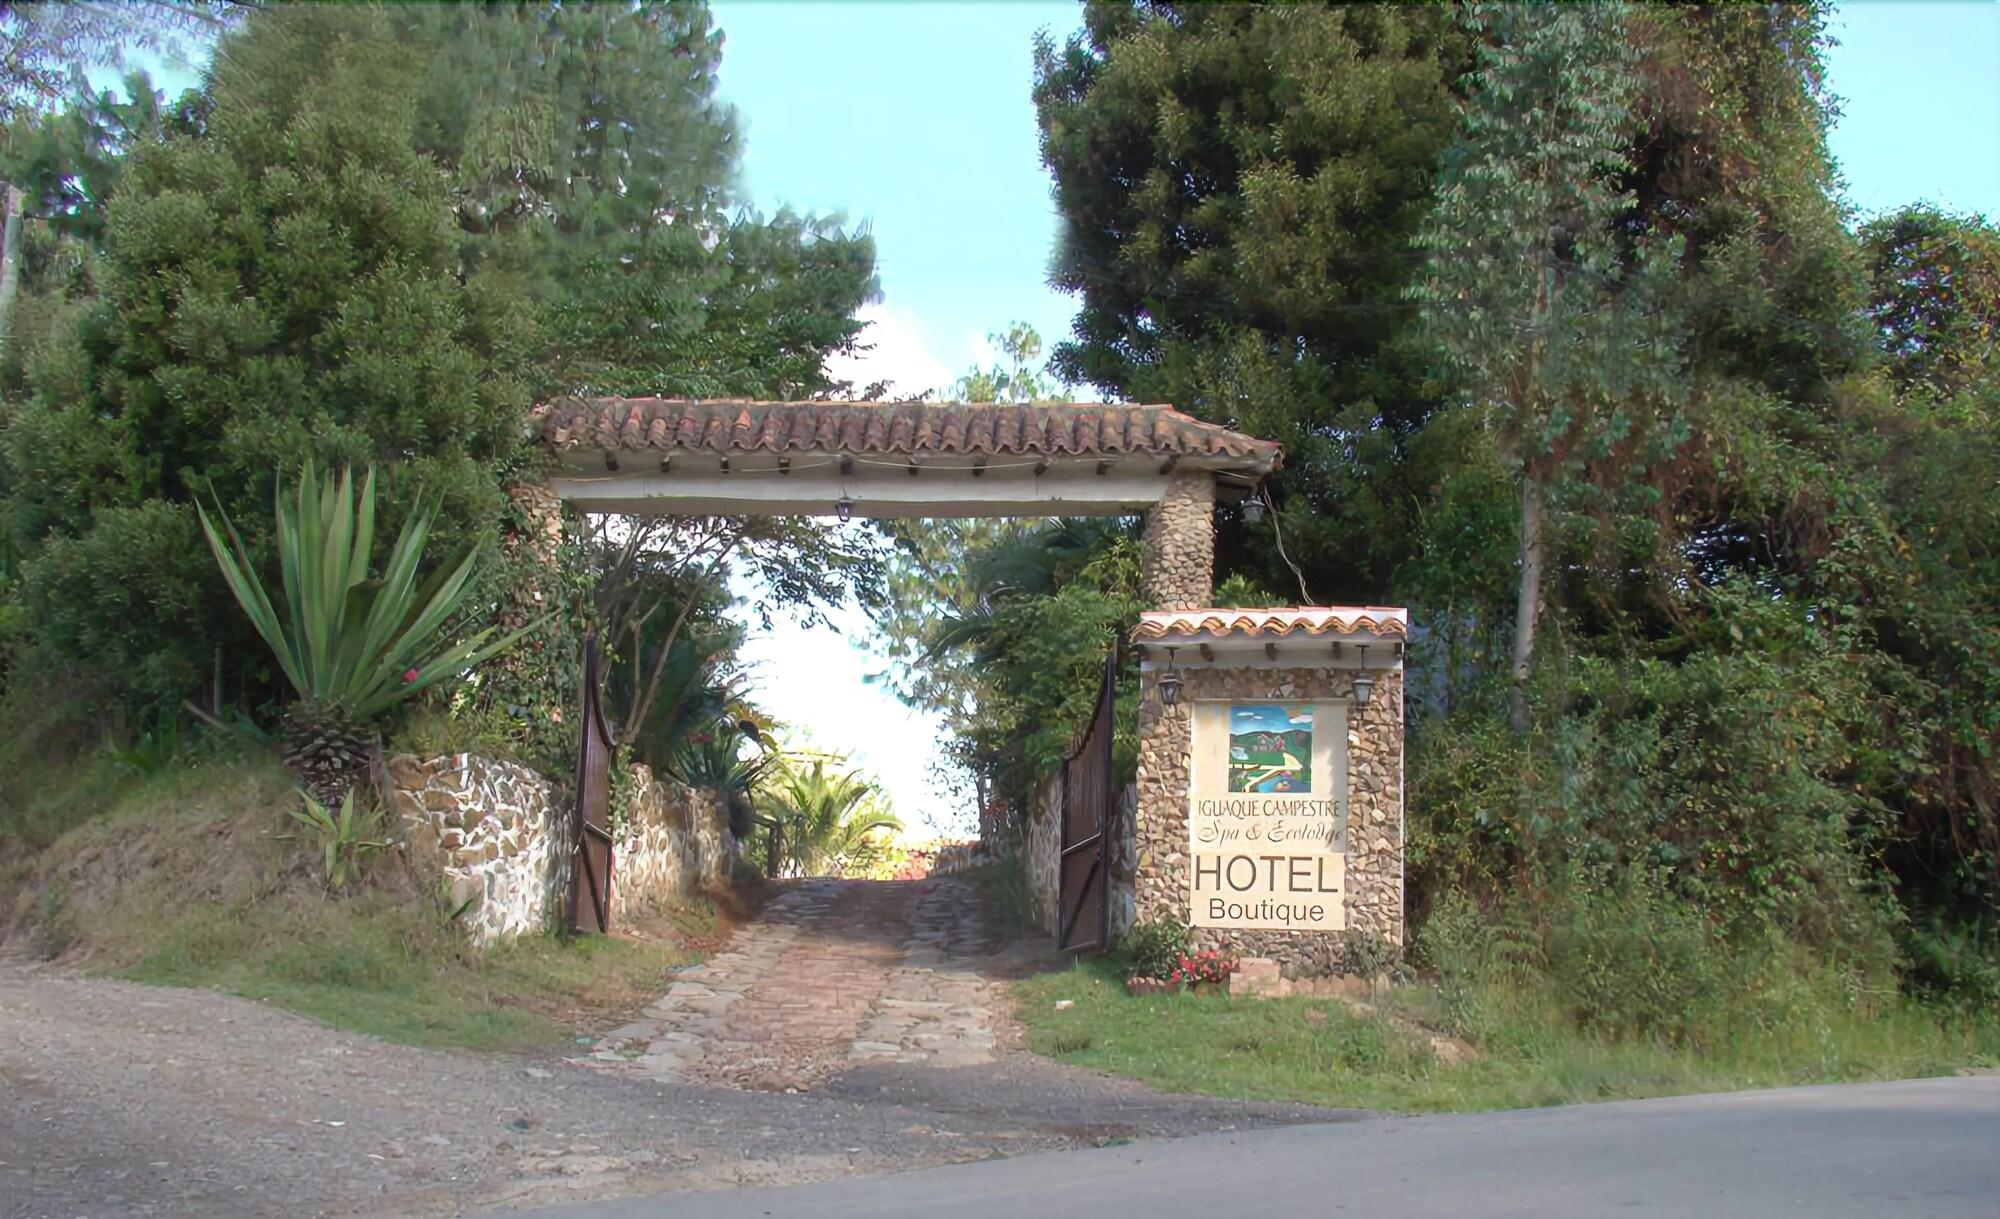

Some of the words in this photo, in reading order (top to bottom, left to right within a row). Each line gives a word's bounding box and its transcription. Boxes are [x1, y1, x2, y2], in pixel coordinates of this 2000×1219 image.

[1198, 800, 1260, 819] IGUAQUE
[1263, 800, 1340, 817] CAMPESTRE
[1197, 819, 1240, 847] Spa
[1195, 854, 1338, 893] HOTEL
[1209, 898, 1324, 926] Boutique
